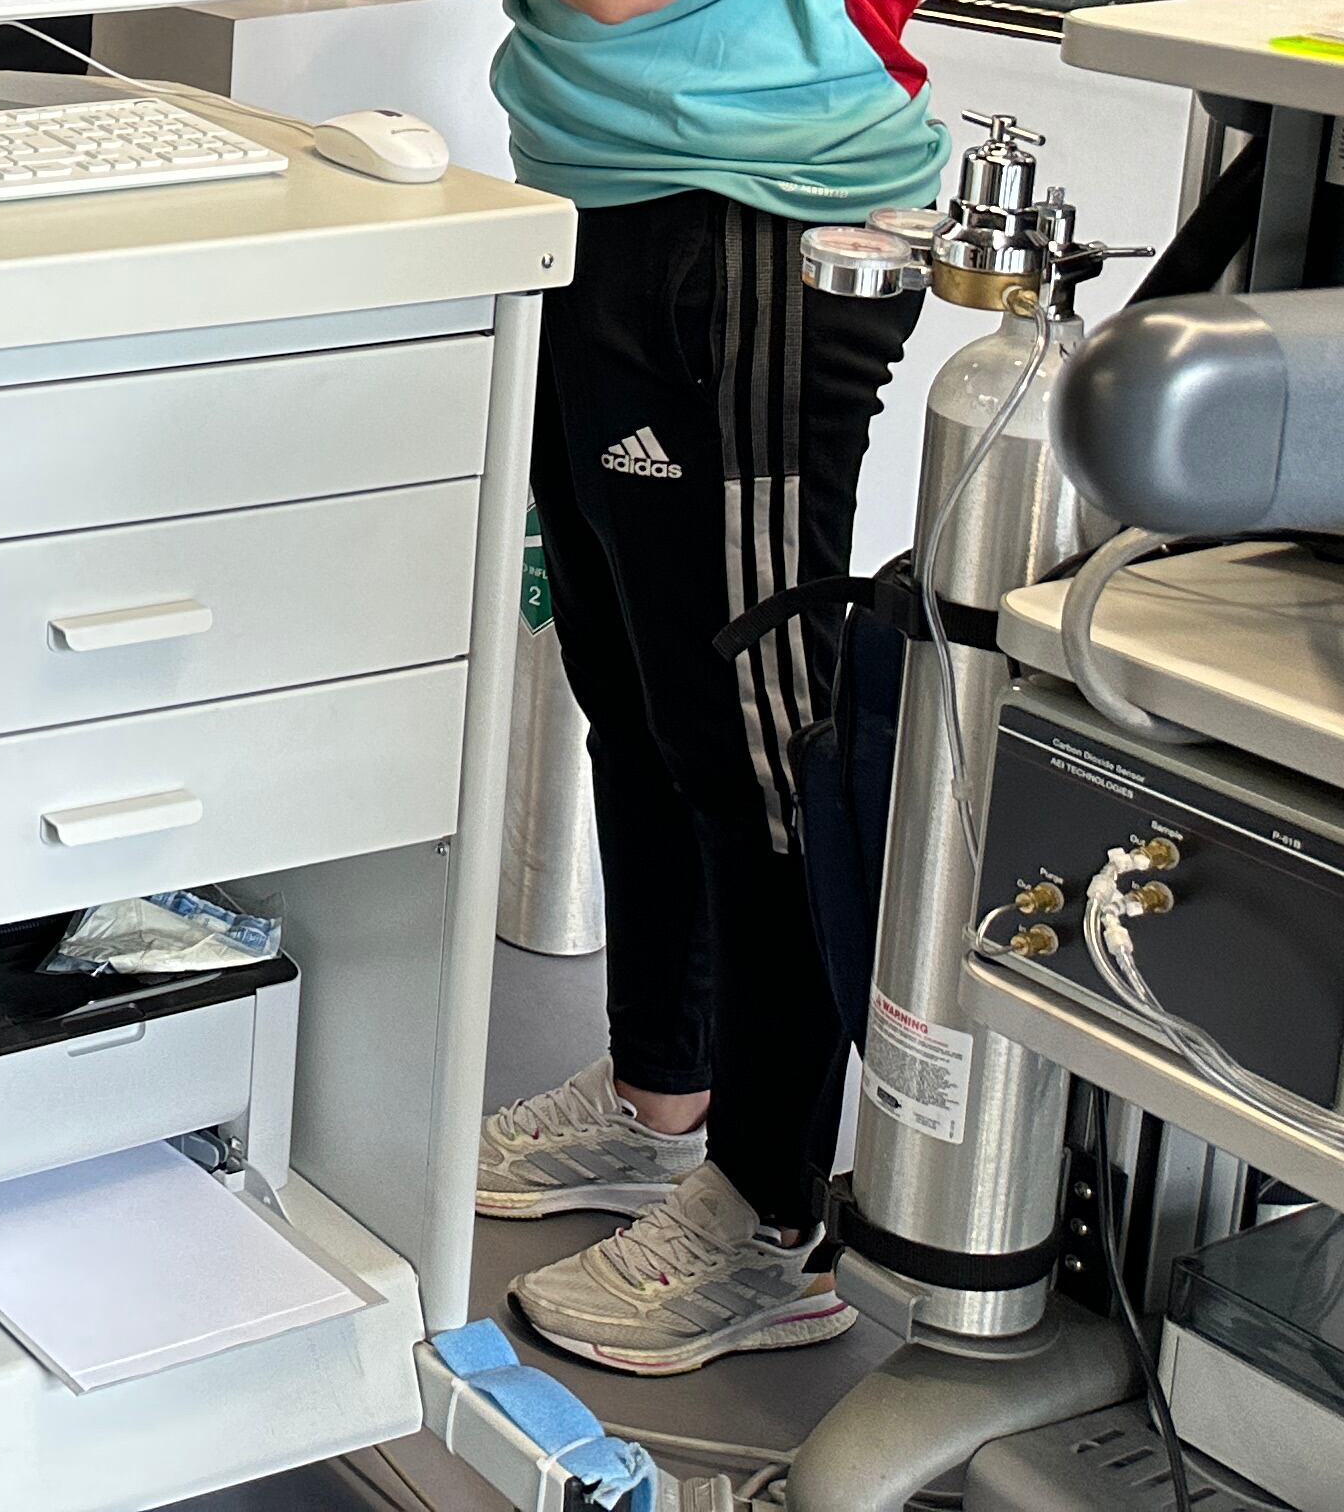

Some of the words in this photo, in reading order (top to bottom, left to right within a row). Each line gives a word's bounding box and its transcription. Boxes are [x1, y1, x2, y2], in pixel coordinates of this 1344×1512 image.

[601, 453, 683, 479] adidas
[528, 585, 542, 606] 2
[1052, 738, 1083, 758] Carbon
[1083, 750, 1114, 772] Dioxide
[1115, 764, 1146, 784] Sensor
[1066, 764, 1134, 799] TECHNOLOGIES
[1151, 820, 1184, 841] Sample
[881, 999, 929, 1034] WARNING
